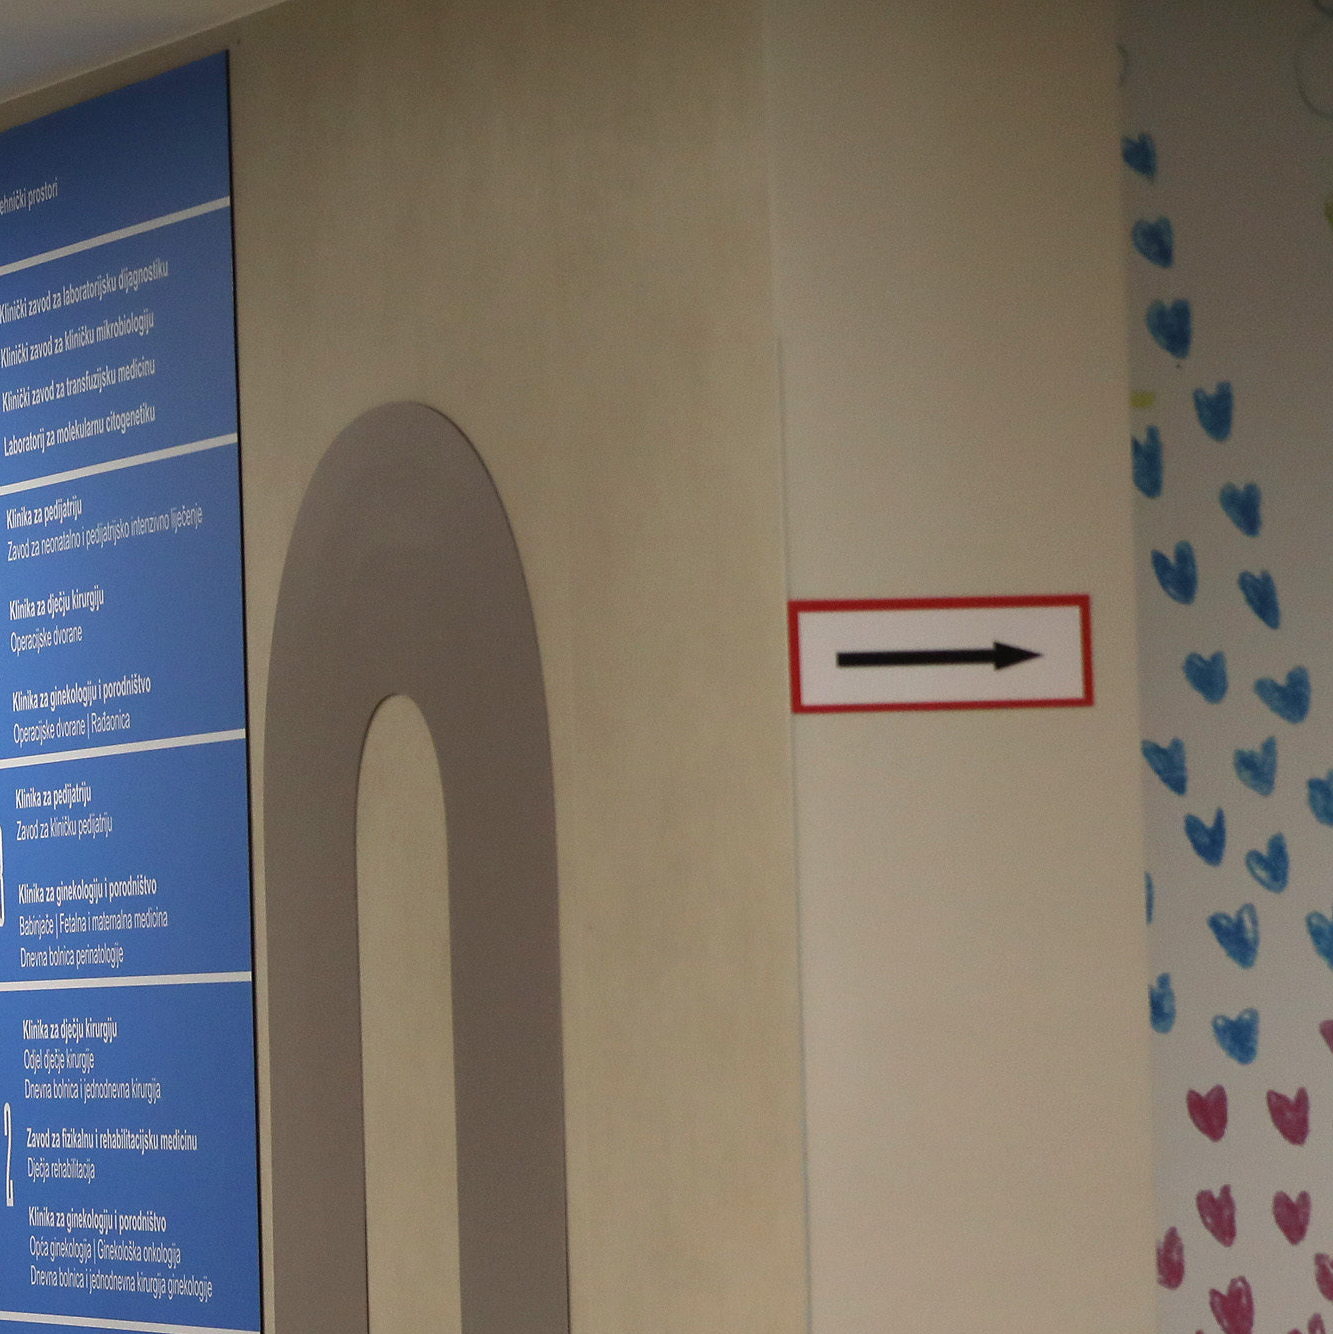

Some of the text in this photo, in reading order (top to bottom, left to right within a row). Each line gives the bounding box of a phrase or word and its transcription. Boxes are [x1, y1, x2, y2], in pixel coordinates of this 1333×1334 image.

[28, 178, 57, 211] prostori
[0, 258, 168, 324] Klinički zavod za laboratorijsku dijagnostiku
[1, 309, 153, 368] Klinički zavod za kliničku mikrobiologiju
[2, 356, 155, 412] Klinički zavod za transfuzijsku medicinu
[4, 403, 155, 456] Laboratorij za molekularnu citogenetiku
[7, 495, 82, 529] Klinika za pedijatriju
[8, 538, 29, 561] Zavod
[10, 585, 104, 620] Klinika za dječju kirurgiju
[13, 674, 151, 712] Klinika za ginekologiju porodništvo
[16, 782, 91, 810] Klinika za pedijatriju
[17, 819, 38, 840] Zavod
[19, 875, 156, 906] Klinika za ginekologiju porodništvo
[21, 948, 47, 967] Dnevna
[23, 1017, 117, 1044] Klinika za dječju kirurgiju
[24, 1049, 42, 1074] Odjel
[25, 1079, 52, 1098] Dnevna
[4, 1102, 13, 1206] 2
[27, 1128, 197, 1155] Zavod za fizikalnu rehabilitacijsku medicinu
[29, 1207, 166, 1235] Klinika za ginekologiju porodništvo
[31, 1265, 57, 1286] Dnevna
